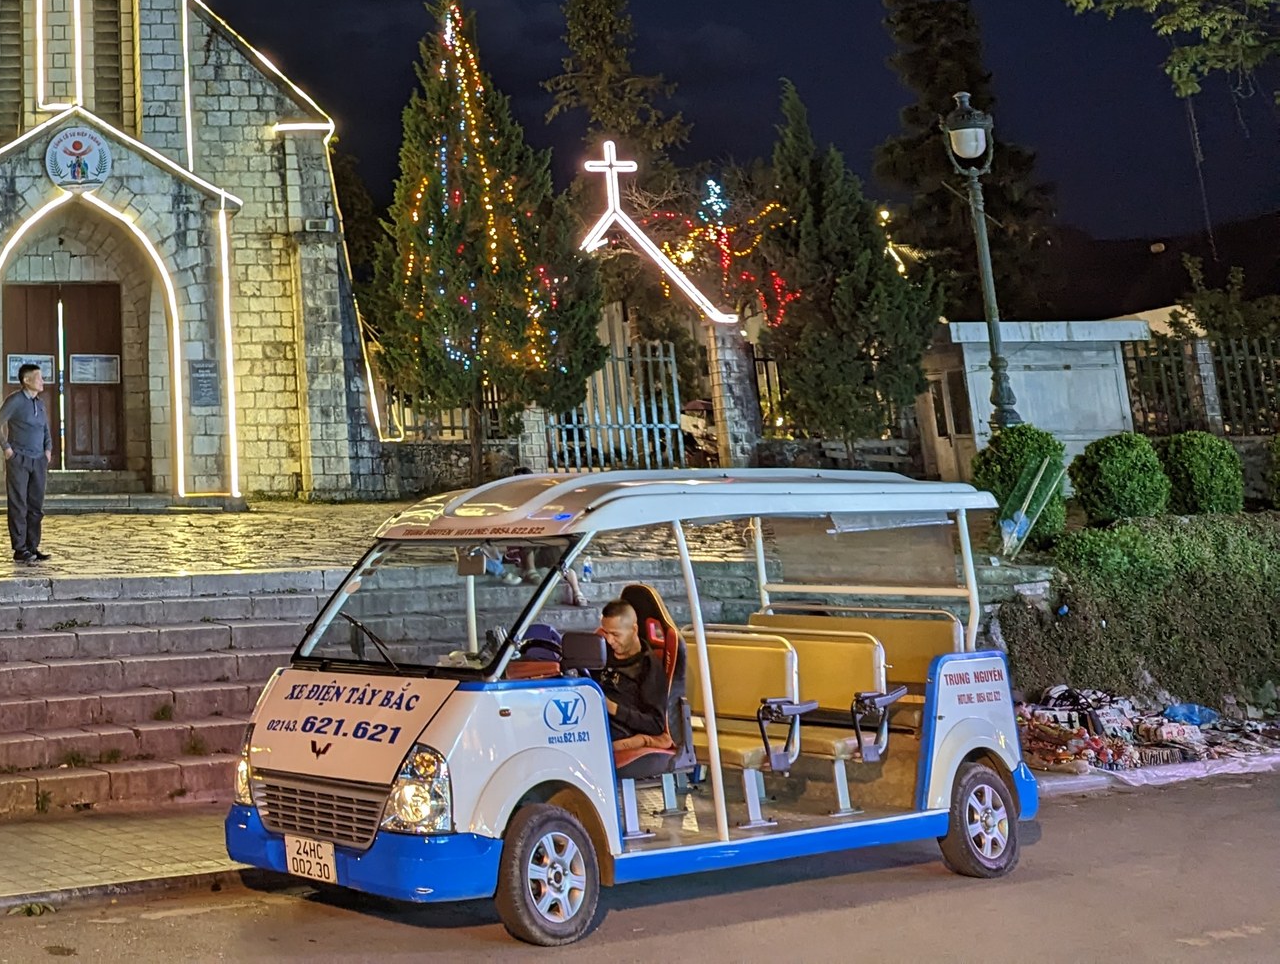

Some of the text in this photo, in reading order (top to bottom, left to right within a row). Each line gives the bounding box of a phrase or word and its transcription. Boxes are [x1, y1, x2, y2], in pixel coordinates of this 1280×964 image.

[944, 667, 1004, 686] TRUNG NGUYÊN
[284, 680, 420, 712] XE ĐIỆN TÂY BẮC
[295, 839, 323, 860] 24HC
[291, 856, 330, 880] 002.30
